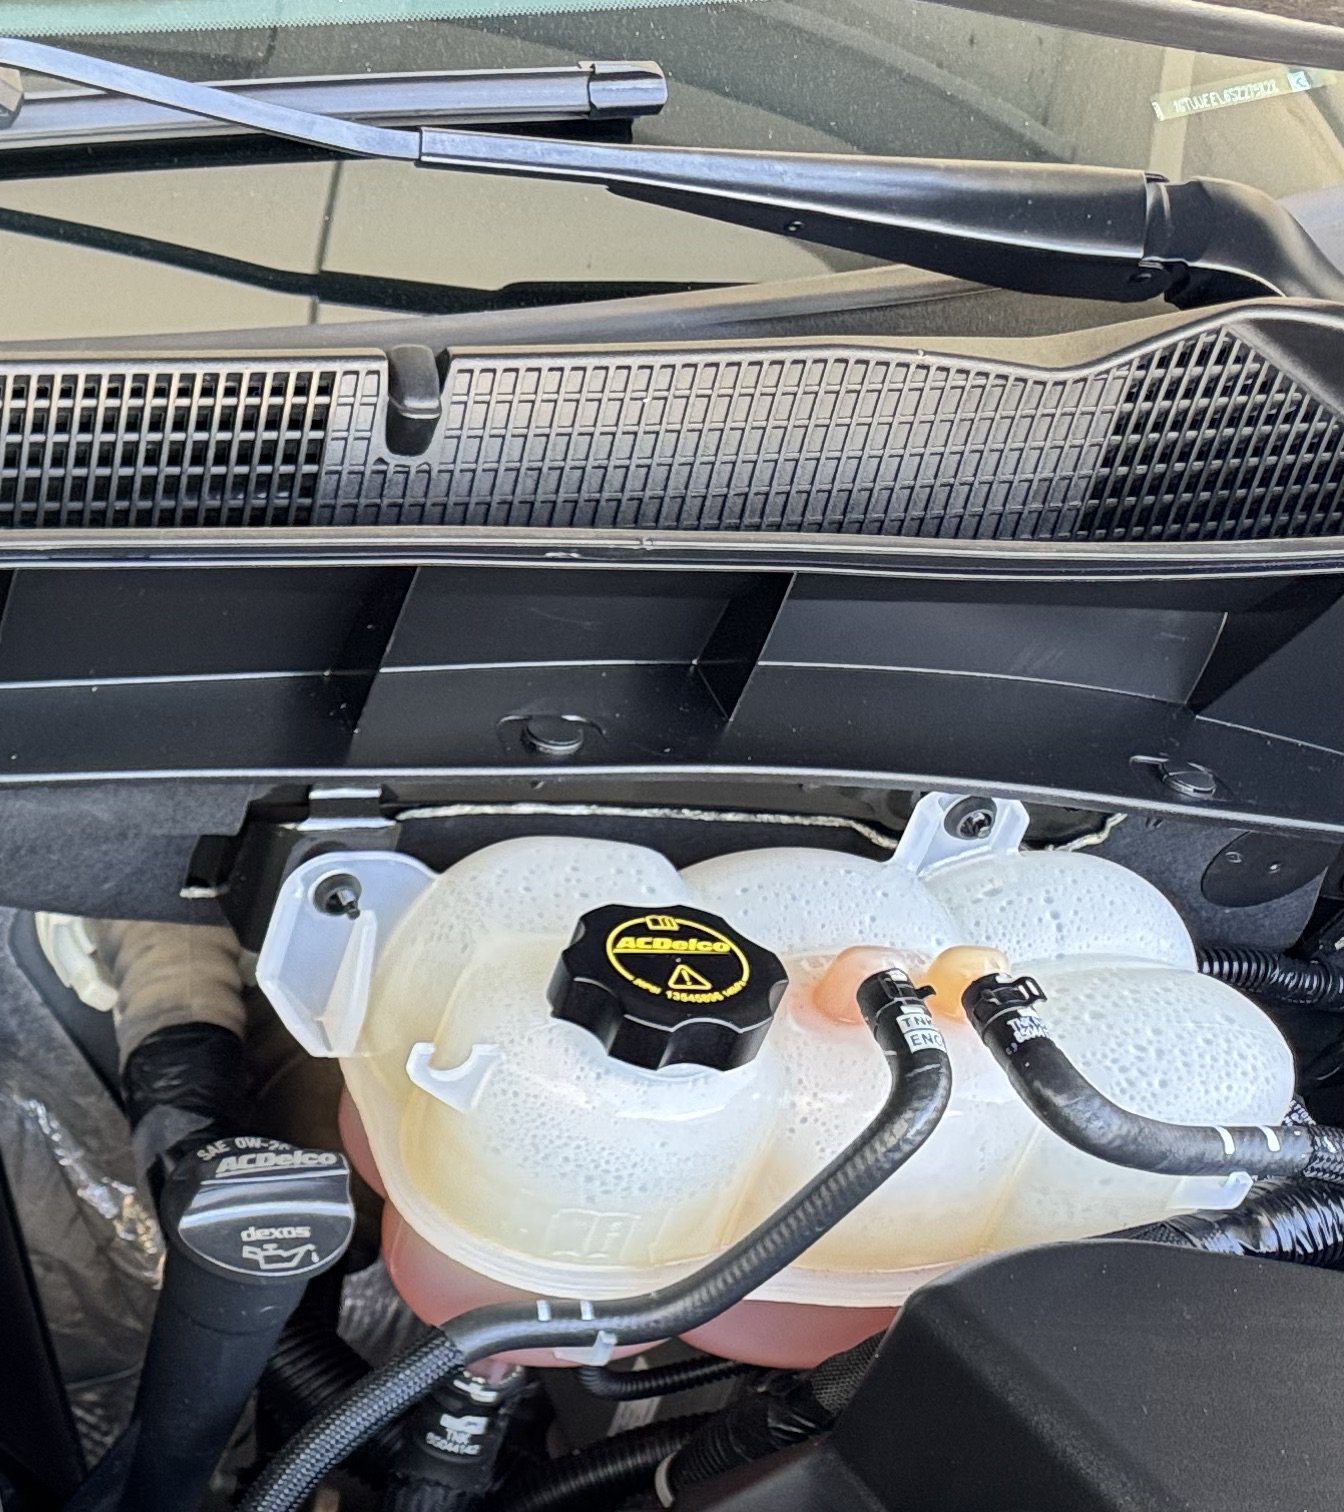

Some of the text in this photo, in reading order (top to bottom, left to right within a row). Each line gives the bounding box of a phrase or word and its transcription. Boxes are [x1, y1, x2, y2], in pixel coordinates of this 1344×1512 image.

[613, 937, 731, 952] ACDelco
[196, 1140, 231, 1161] SAE
[215, 1151, 338, 1173] ACDelco
[240, 1225, 312, 1242] dexos
